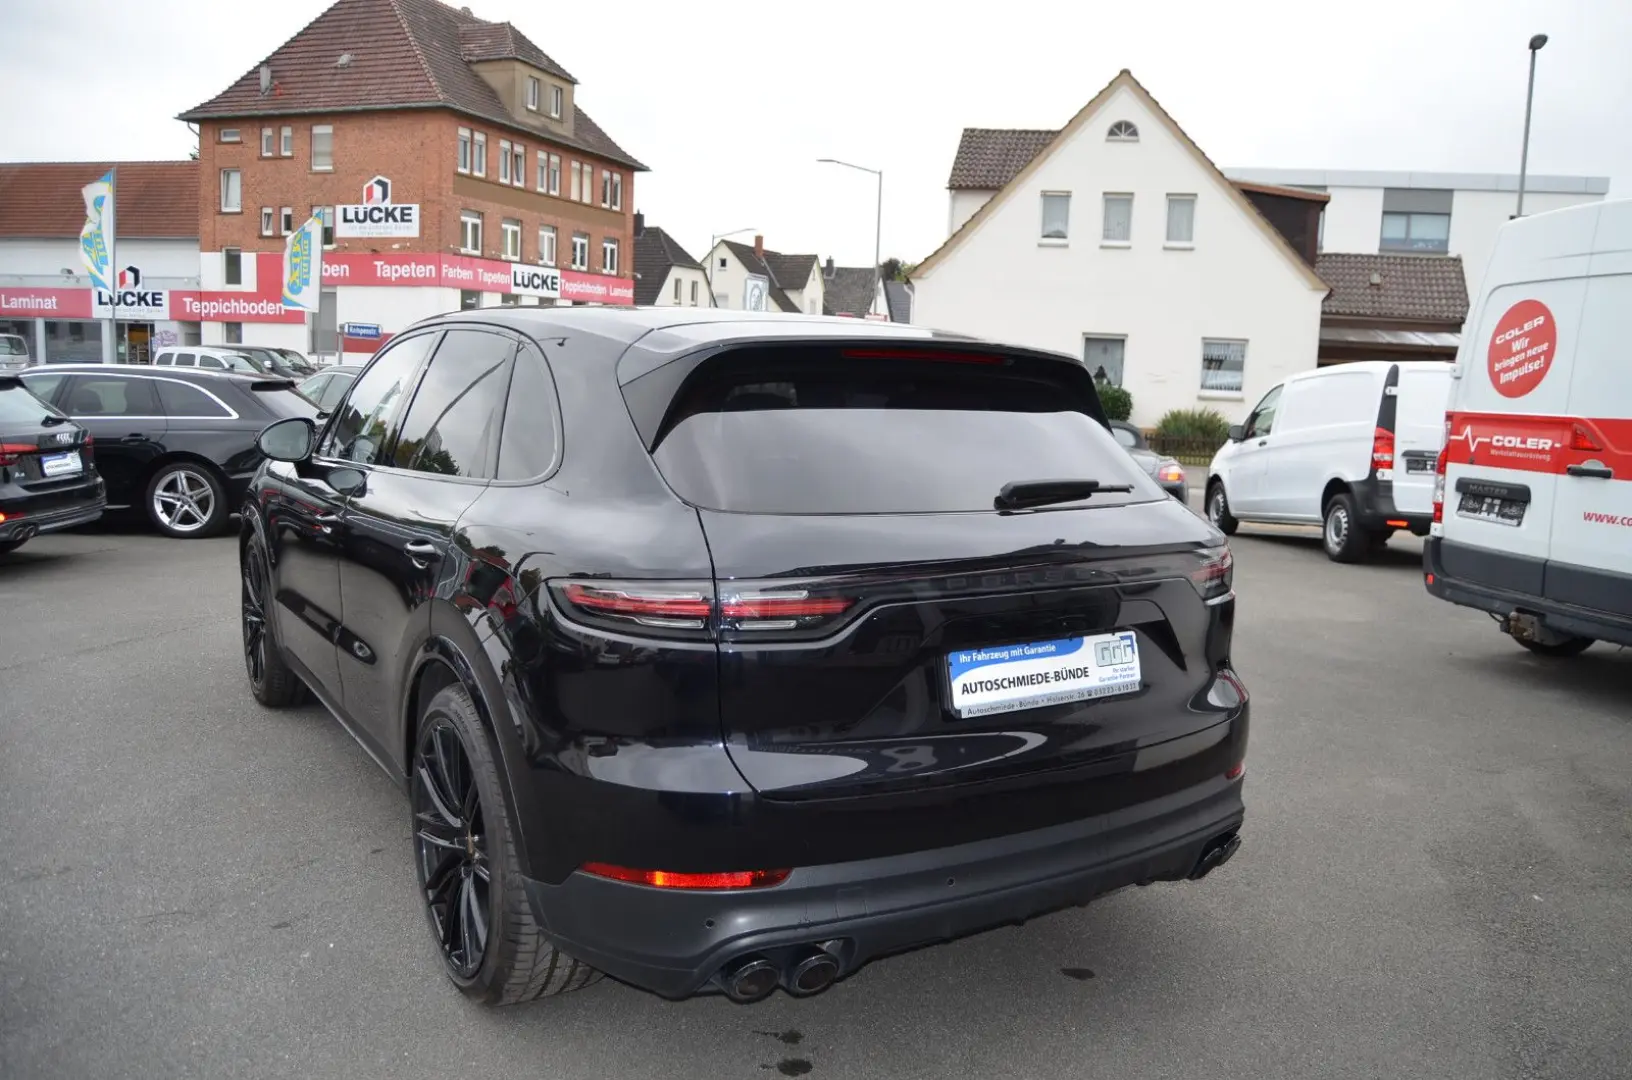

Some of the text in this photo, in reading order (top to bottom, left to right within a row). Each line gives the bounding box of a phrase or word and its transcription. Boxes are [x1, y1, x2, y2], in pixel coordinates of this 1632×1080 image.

[373, 261, 436, 280] Tapeten
[442, 264, 510, 285] Farben Tapeten
[561, 280, 607, 296] Teppichboden
[1, 296, 58, 310] Laminat
[183, 298, 285, 317] Teppichboden
[1495, 315, 1545, 344] COLER
[1511, 336, 1530, 353] Wir
[1494, 342, 1549, 372] bringen neue
[1500, 355, 1544, 384] Impulse!
[1491, 435, 1552, 450] COLER
[1469, 483, 1508, 495] MASTER
[959, 644, 1056, 663] Ihr Fahrzeug mit Garantie
[961, 666, 1089, 695] AUTOSCHMIEDE-BÜNDE
